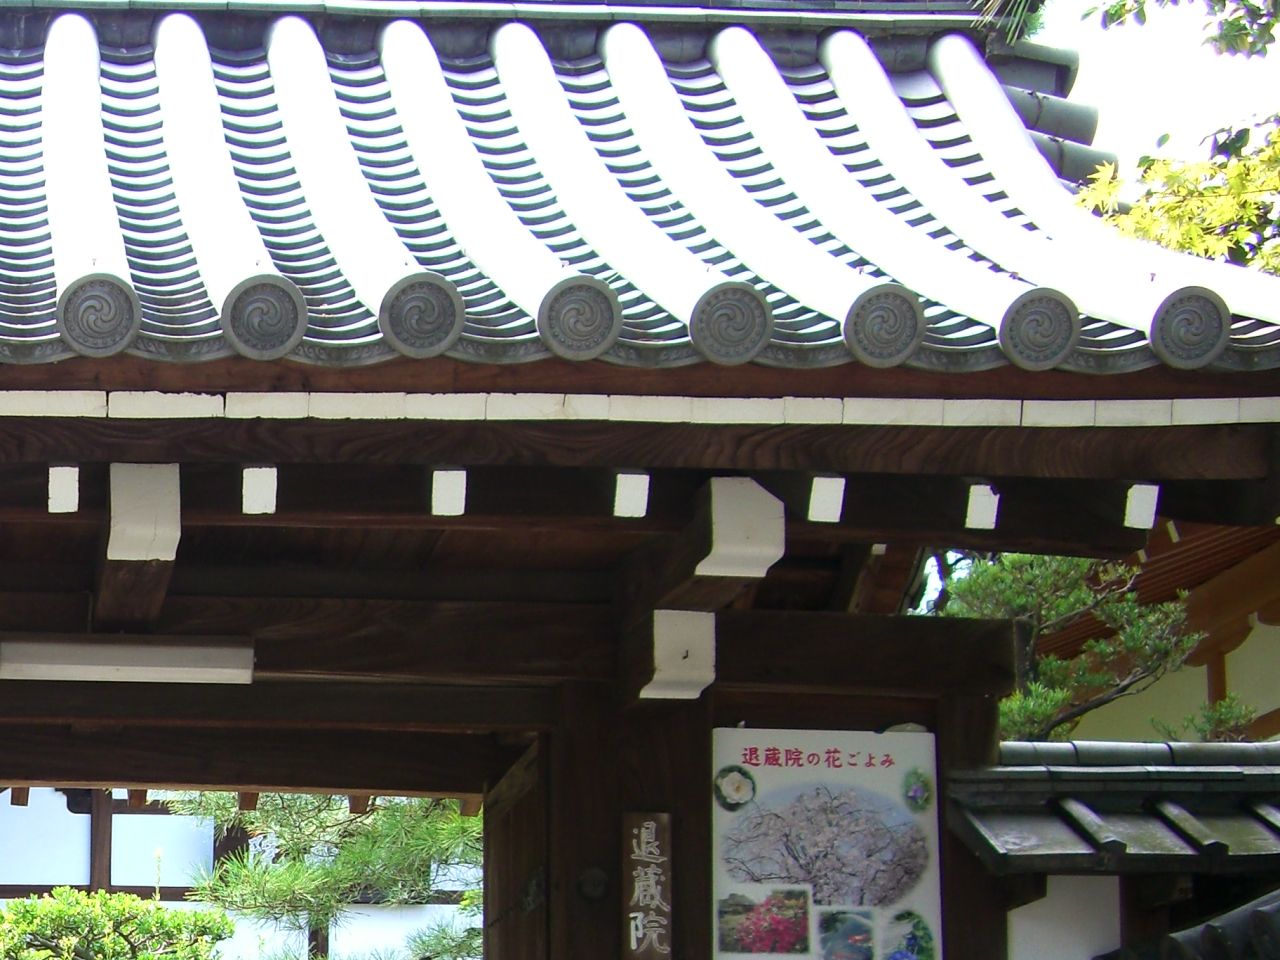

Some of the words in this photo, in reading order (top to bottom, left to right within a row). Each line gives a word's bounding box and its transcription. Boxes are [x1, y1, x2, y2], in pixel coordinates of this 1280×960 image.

[741, 746, 896, 769] 退蔵院の花ごよみ
